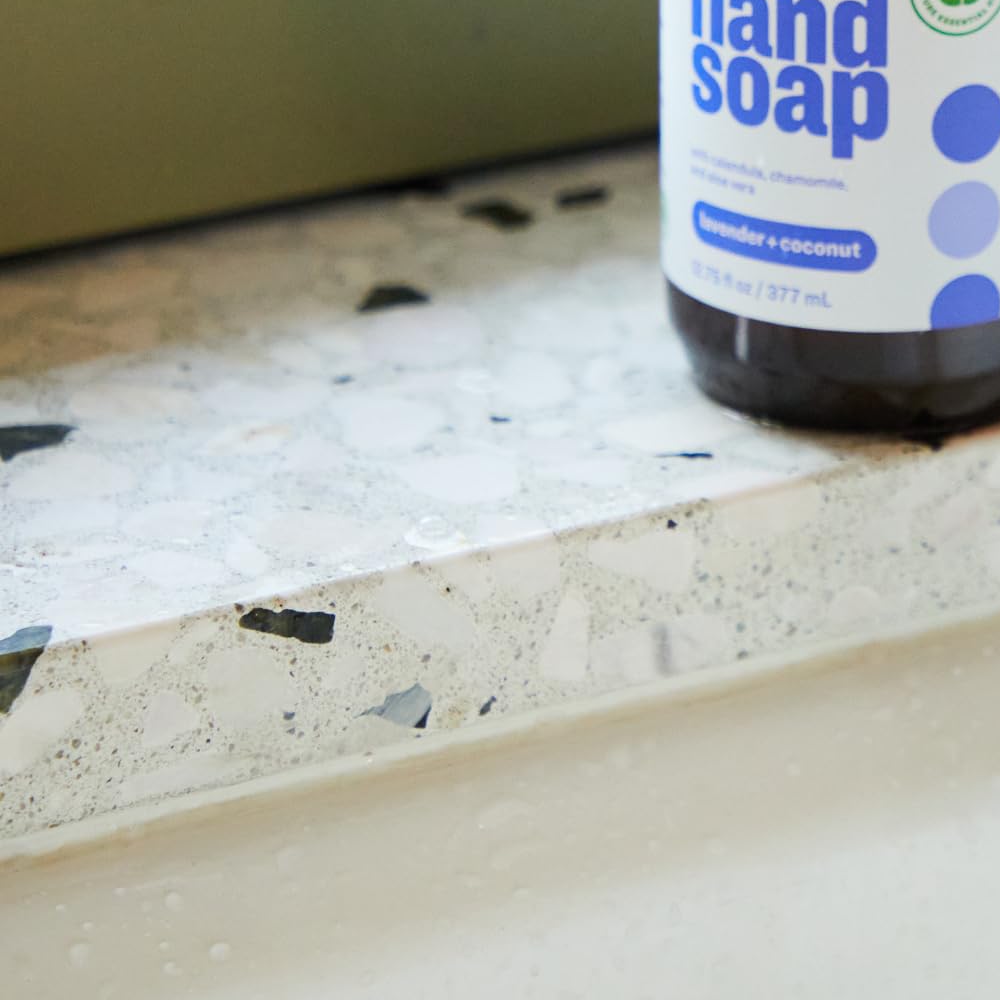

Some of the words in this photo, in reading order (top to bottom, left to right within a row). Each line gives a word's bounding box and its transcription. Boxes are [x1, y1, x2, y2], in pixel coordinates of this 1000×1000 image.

[691, 43, 889, 160] soap
[699, 211, 766, 248] lavender
[779, 237, 862, 259] coconut
[767, 283, 800, 305] 377
[804, 290, 833, 309] mL
